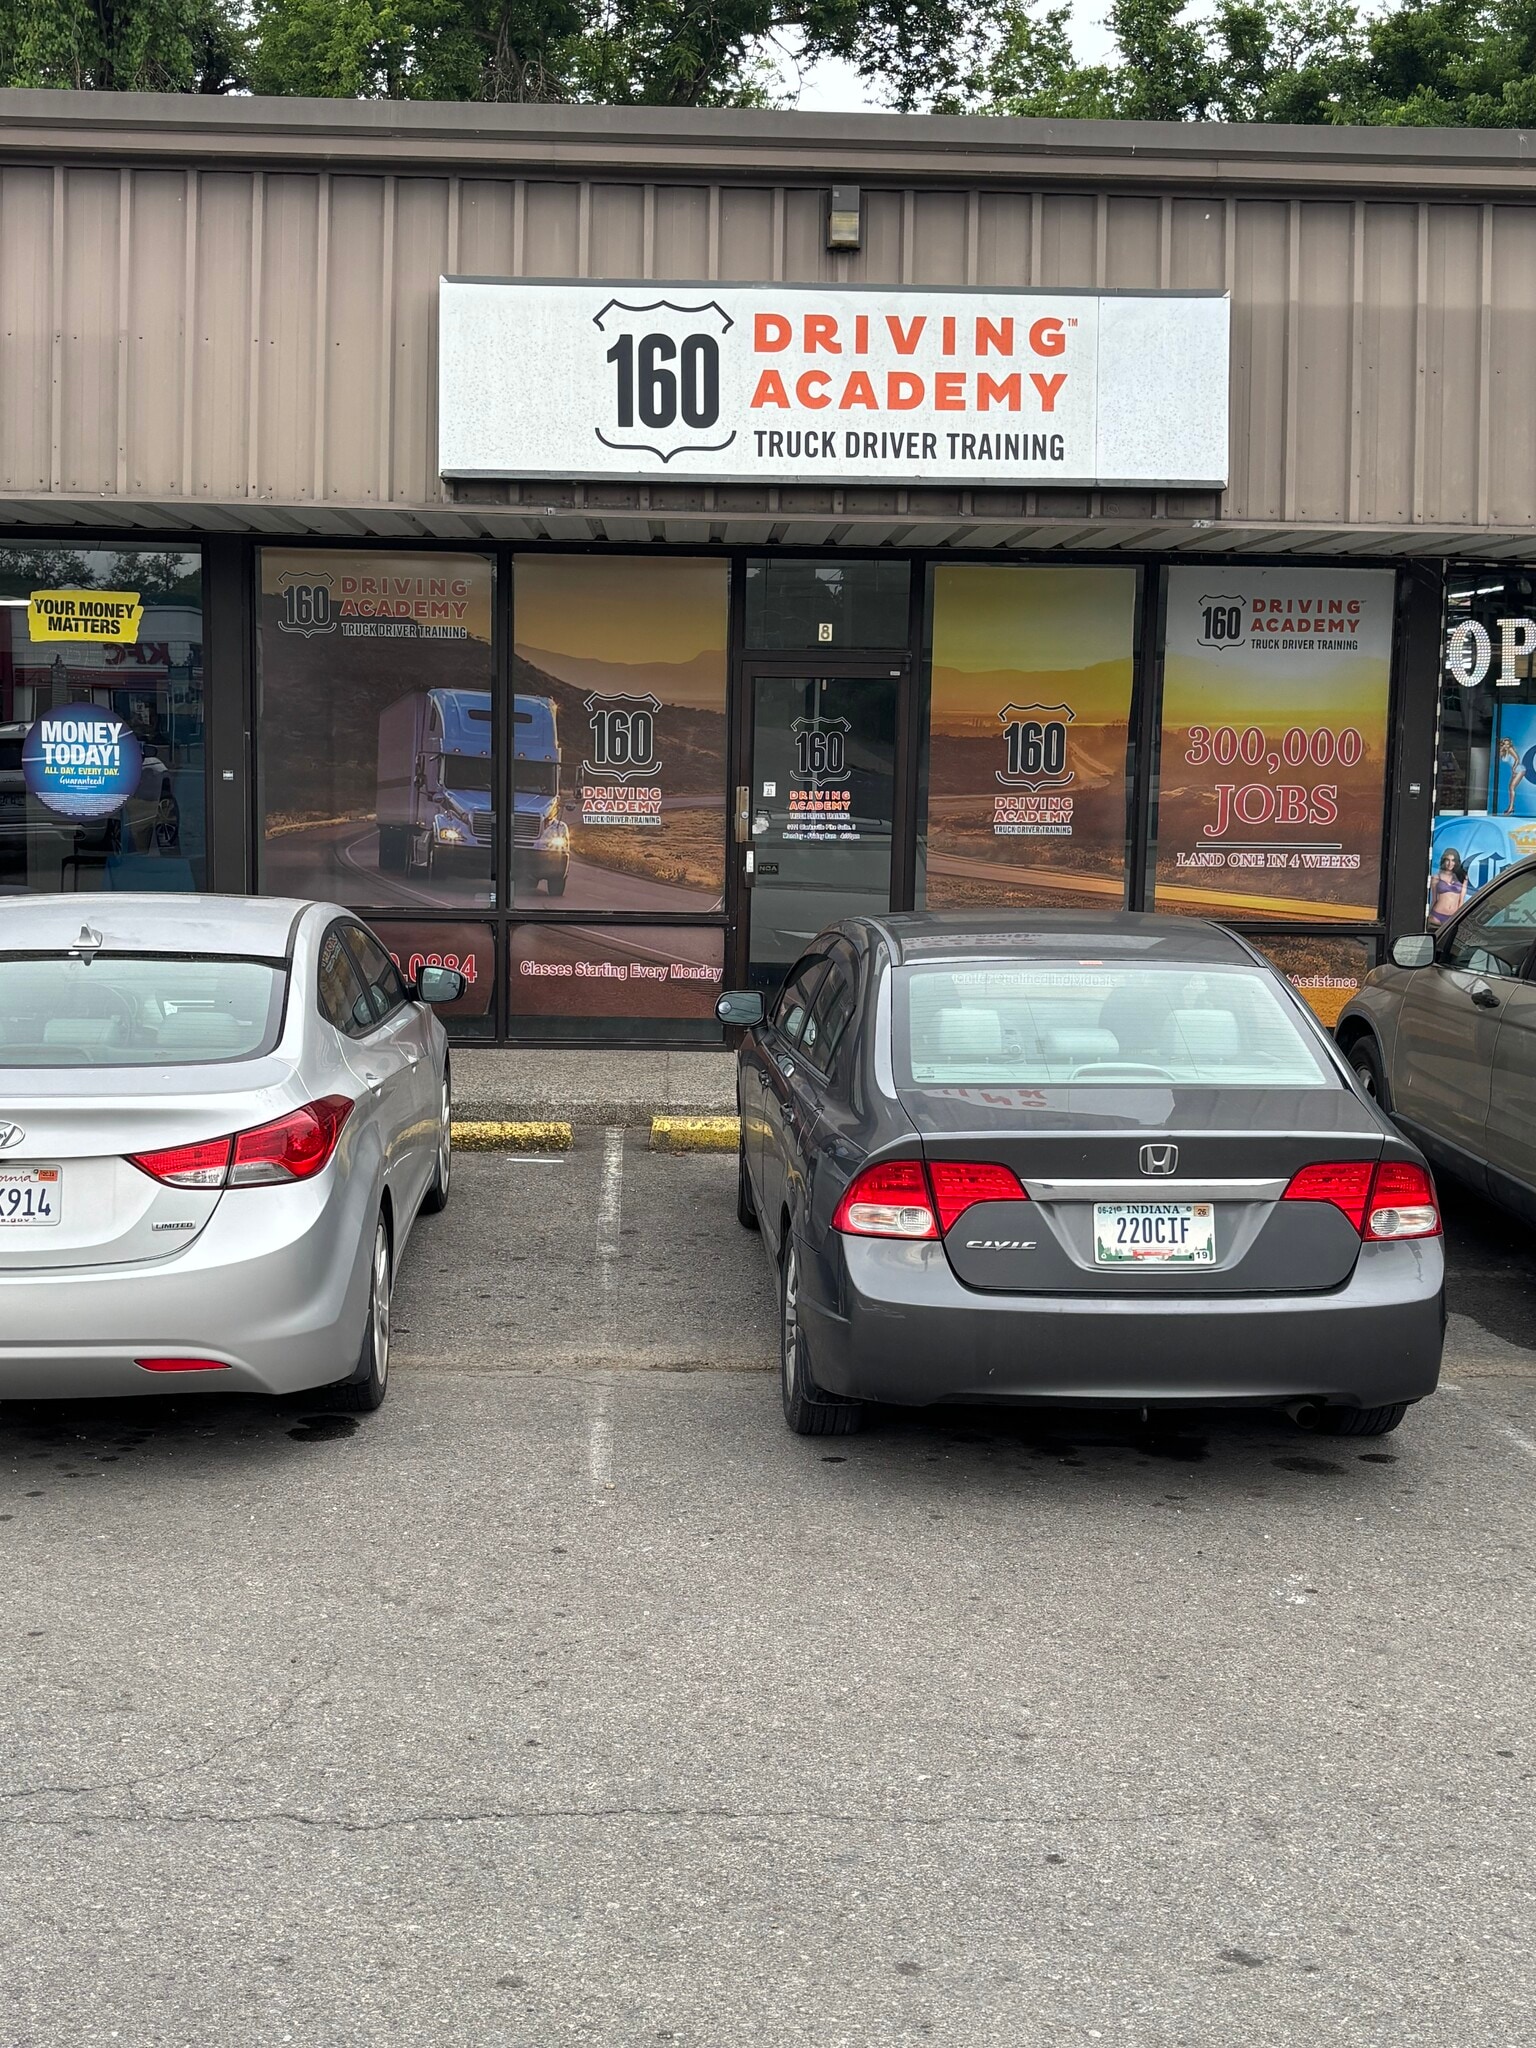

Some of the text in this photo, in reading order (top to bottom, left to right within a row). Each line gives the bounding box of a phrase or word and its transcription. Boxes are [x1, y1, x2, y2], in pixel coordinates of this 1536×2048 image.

[753, 312, 1066, 358] DRIVING
[606, 332, 720, 429] 160
[749, 369, 1069, 413] ACADEMY
[753, 430, 1065, 461] TRUCK DRIVER TRAINING
[340, 575, 469, 597] DRIVING
[33, 598, 136, 619] YOUR MONEY
[282, 584, 332, 626] 160
[339, 598, 469, 620] ACADEMY
[1251, 598, 1362, 615] DRIVING
[47, 616, 121, 635] MATTERS
[342, 622, 468, 639] TRUCK DRIVER TRAINING
[1201, 606, 1242, 640] 160
[1249, 617, 1361, 634] ACADEMY
[820, 624, 830, 640] 8
[1250, 638, 1359, 651] TRUCK DRIVER TRAINING
[41, 720, 123, 744] MONEY
[589, 709, 654, 766] 160
[41, 743, 120, 766] TODAY!
[794, 730, 846, 774] 160
[1002, 720, 1067, 775] 160
[1184, 725, 1364, 775] 300,000
[44, 766, 120, 776] ALL DAY. EVERY DAY.
[59, 775, 105, 786] Guaranteed!
[582, 786, 662, 800] DRIVING
[789, 790, 850, 800] DRIVING
[581, 799, 662, 814] ACADEMY
[789, 801, 850, 810] ACADEMY
[994, 797, 1074, 810] DRIVING
[1202, 783, 1339, 837] JOBS
[583, 814, 661, 825] TRUCK DRIVER TRAINING
[993, 809, 1074, 823] ACADEMY
[995, 824, 1072, 835] TRUCK DRIVER TRAINING
[1175, 852, 1362, 870] LAND ONE IN 4 WEEKS
[519, 960, 724, 982] Classes Starting Every Monday
[1050, 973, 1116, 987] Individuals
[1291, 974, 1358, 989] Assistance
[1126, 1205, 1181, 1215] INDIANA
[155, 1222, 194, 1230] LIMITED
[965, 1240, 1038, 1252] CIVIC
[1195, 1251, 1208, 1260] 19
